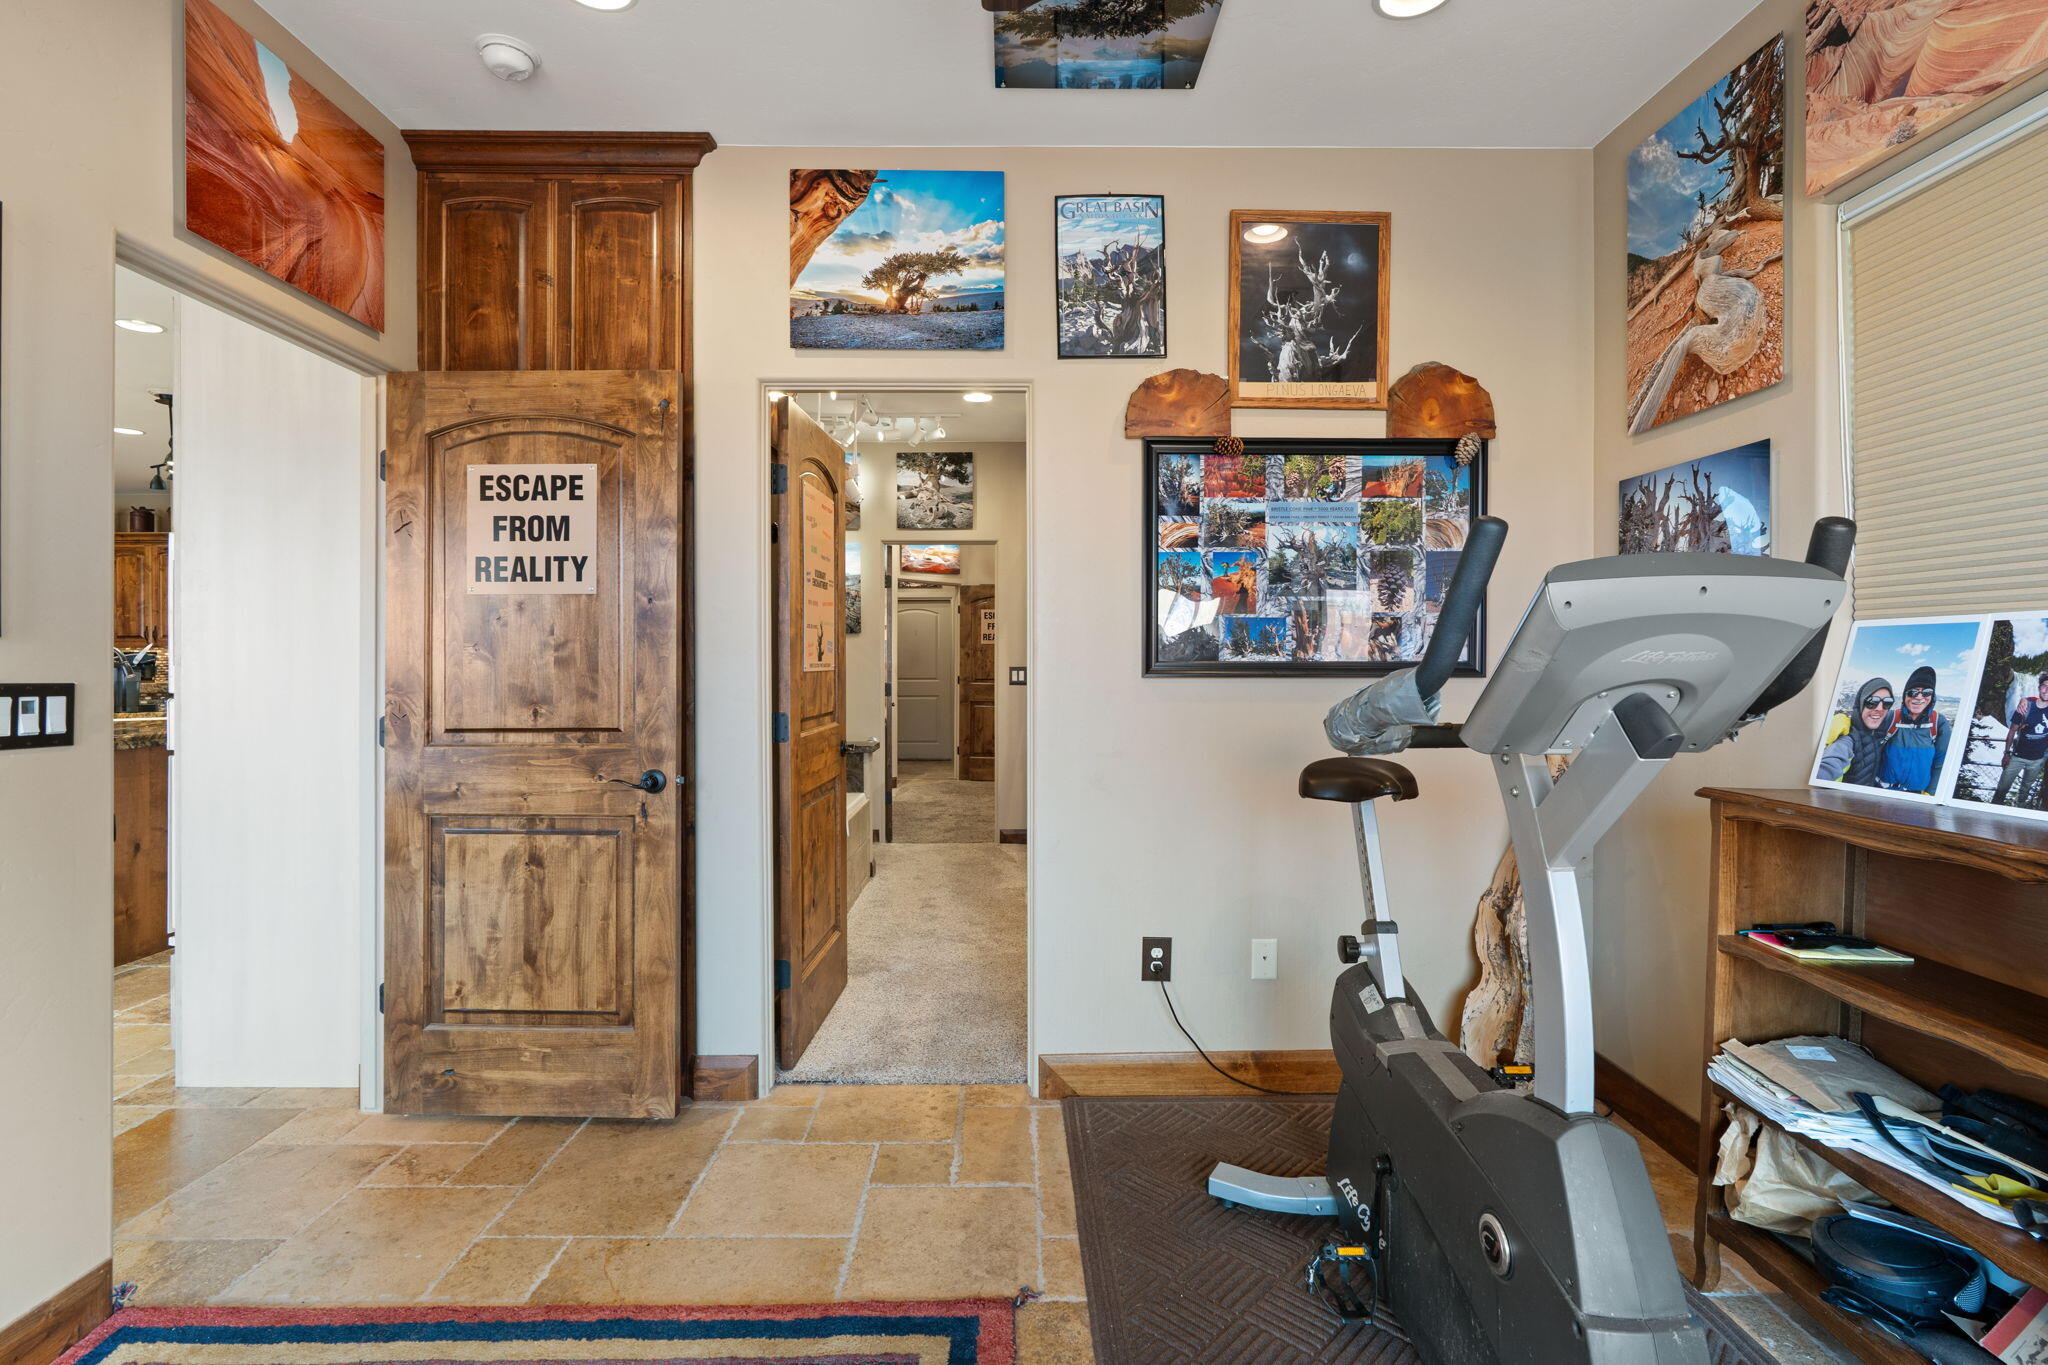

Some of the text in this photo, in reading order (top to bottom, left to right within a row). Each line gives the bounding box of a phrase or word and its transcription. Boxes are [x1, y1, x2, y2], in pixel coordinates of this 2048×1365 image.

[1060, 201, 1159, 219] GREAT BASIN
[1266, 383, 1367, 398] PINUS LONGAEVA
[479, 474, 584, 502] ESCAPE
[493, 515, 570, 542] FROM
[475, 555, 589, 583] REALITY
